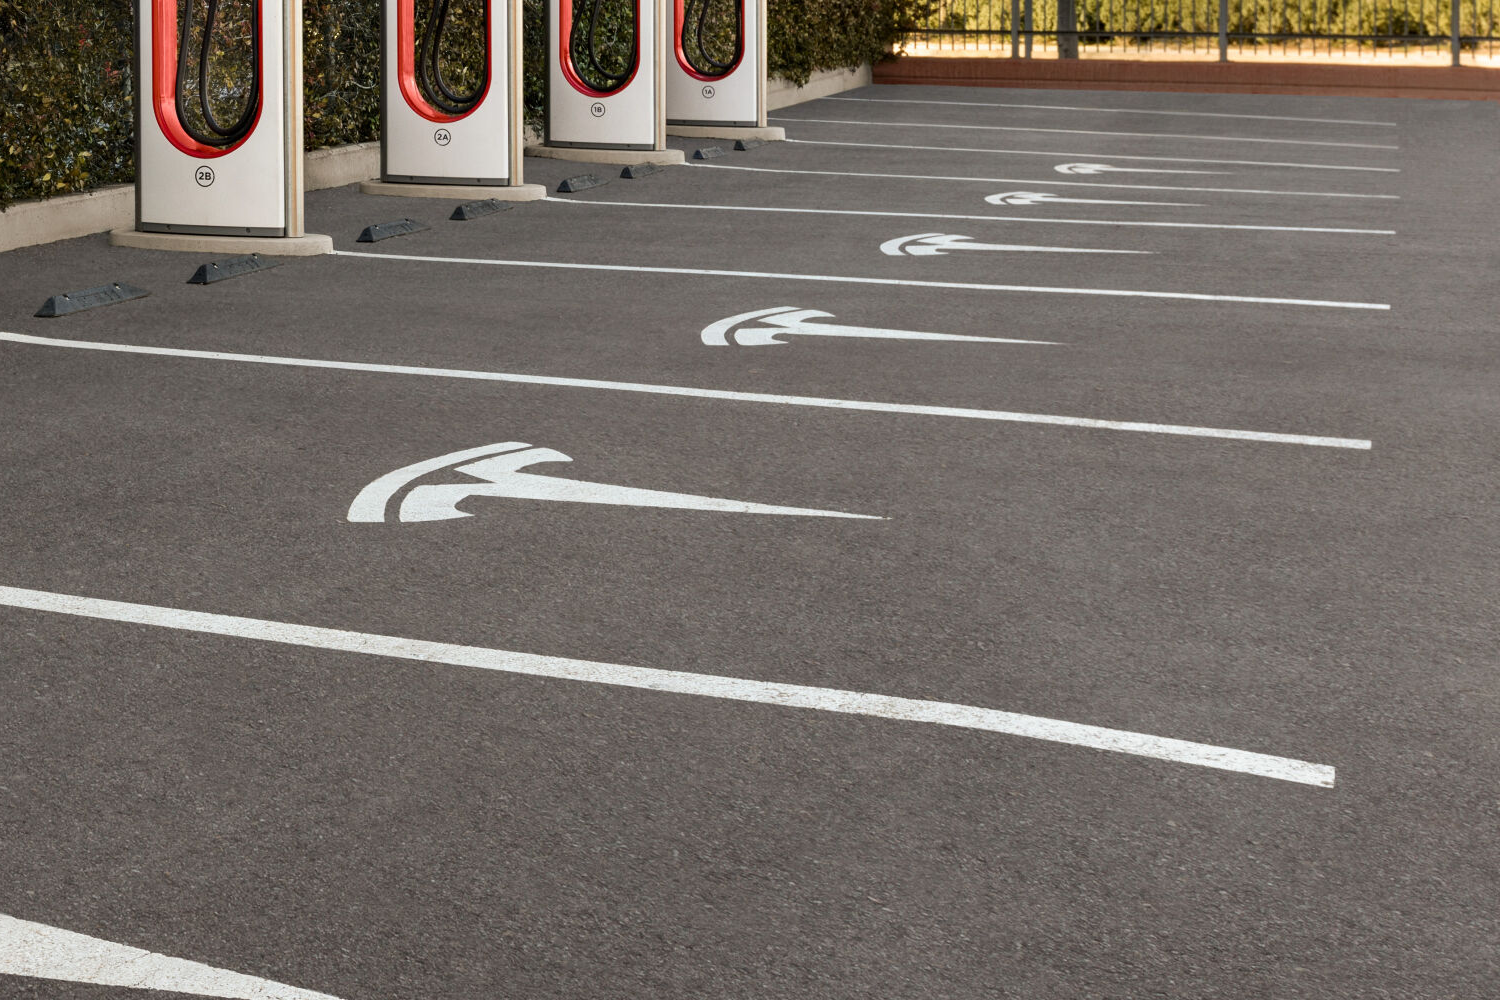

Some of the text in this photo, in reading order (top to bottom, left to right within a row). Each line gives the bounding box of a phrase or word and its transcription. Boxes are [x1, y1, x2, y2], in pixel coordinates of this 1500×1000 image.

[593, 106, 603, 114] 1B
[436, 132, 449, 142] 2A
[198, 171, 212, 181] 2B
